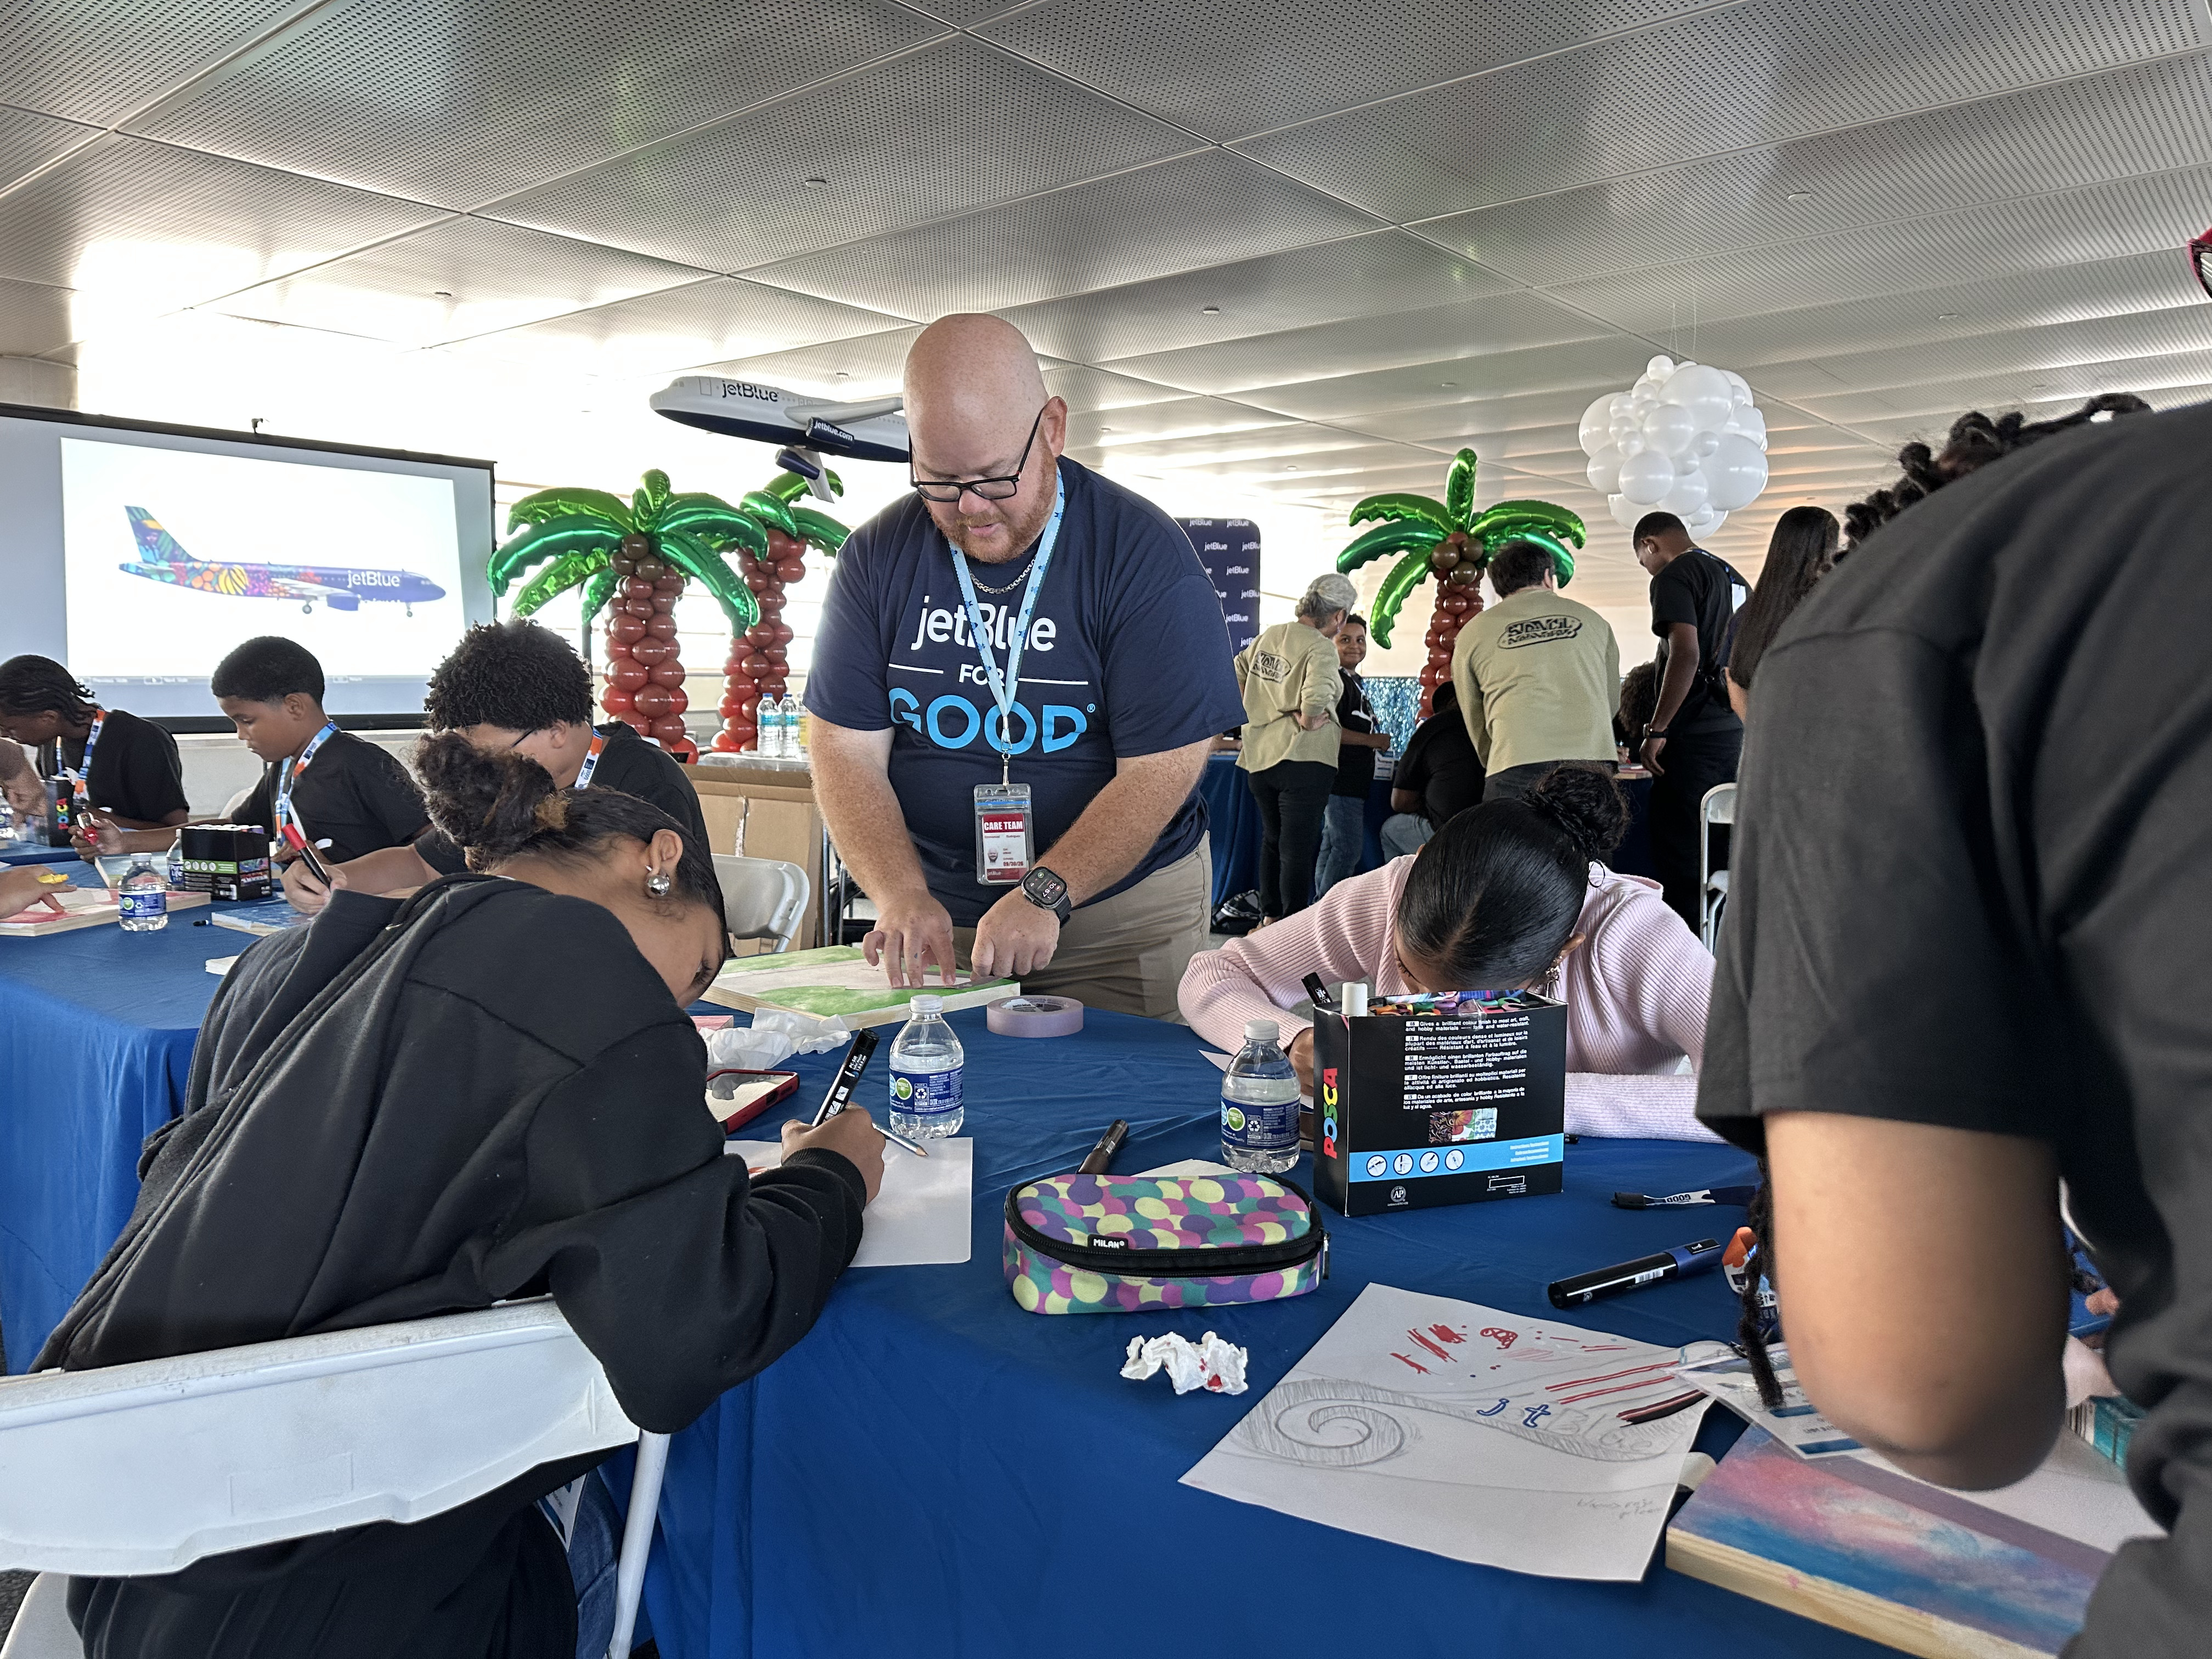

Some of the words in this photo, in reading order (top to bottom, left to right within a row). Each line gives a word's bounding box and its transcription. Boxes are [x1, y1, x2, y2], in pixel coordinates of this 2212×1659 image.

[722, 380, 779, 402] jetBlue
[814, 420, 854, 442] jetblue.com
[1227, 519, 1249, 527] jetBlue
[1204, 542, 1227, 551] jetBlue
[1242, 542, 1260, 551] jetBlu
[1226, 566, 1249, 575] jetBlue
[347, 570, 400, 588] jetBlue
[1241, 590, 1260, 599] jetBlu
[911, 595, 1056, 651] jetBlue
[1226, 614, 1249, 622] jetBlue
[958, 663, 1005, 686] FOR
[984, 821, 1003, 831] CARE
[1003, 821, 1023, 830] TEAM
[1323, 1067, 1338, 1159] POSCA
[1393, 1190, 1404, 1198] AP
[1667, 1194, 1691, 1203] GOOD
[1093, 1238, 1119, 1249] MILAN
